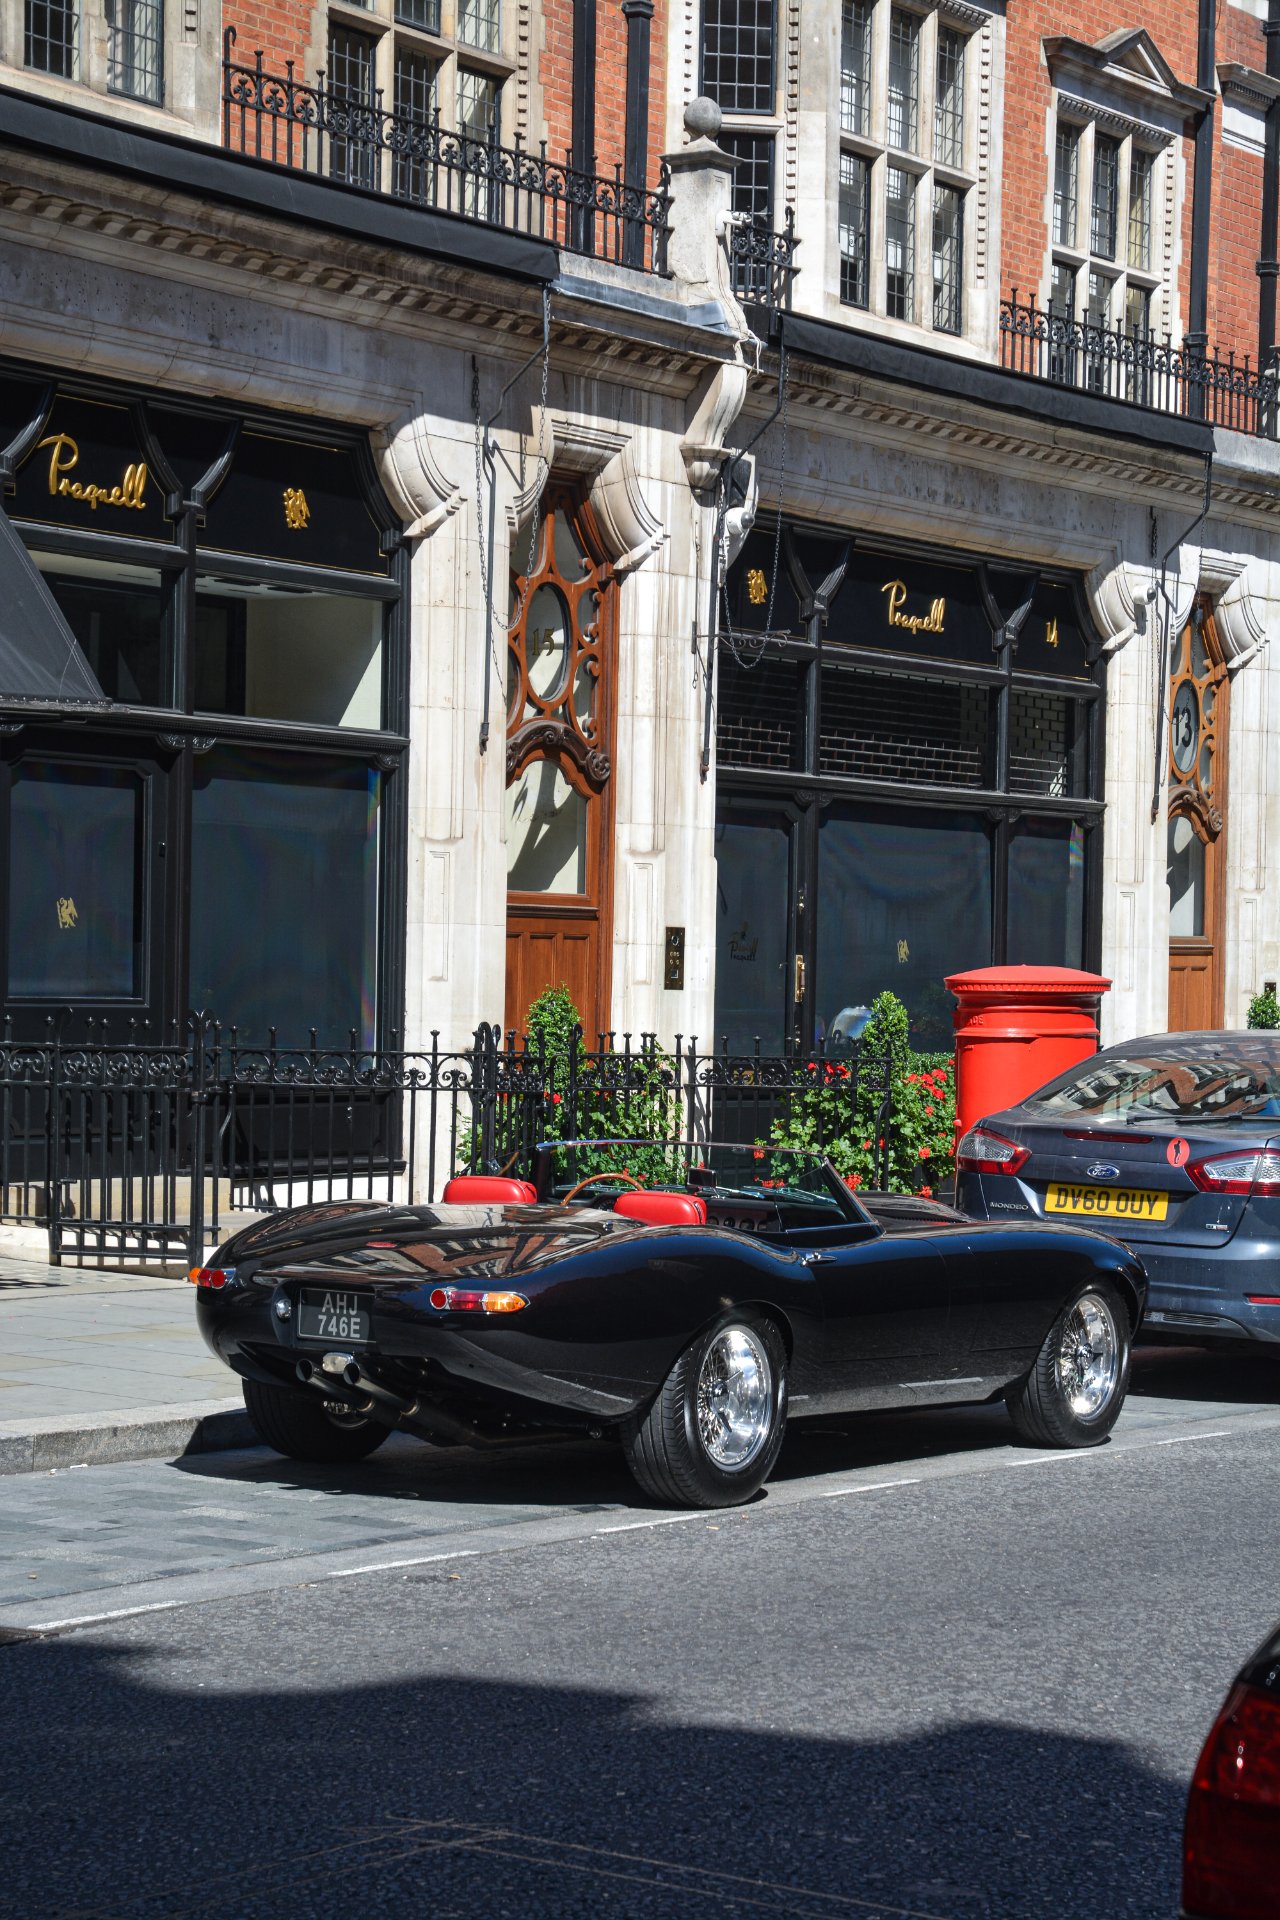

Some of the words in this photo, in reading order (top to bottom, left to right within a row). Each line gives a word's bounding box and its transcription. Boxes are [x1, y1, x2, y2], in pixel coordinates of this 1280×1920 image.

[36, 432, 147, 510] Pragnell
[881, 579, 946, 635] Pragnell
[532, 627, 555, 656] 15
[1173, 706, 1192, 748] 13
[990, 1201, 1029, 1210] MONDEO
[1055, 1187, 1110, 1212] DV60
[1115, 1192, 1159, 1216] OUY
[321, 1292, 358, 1316] AHJ
[318, 1314, 361, 1339] 746E
